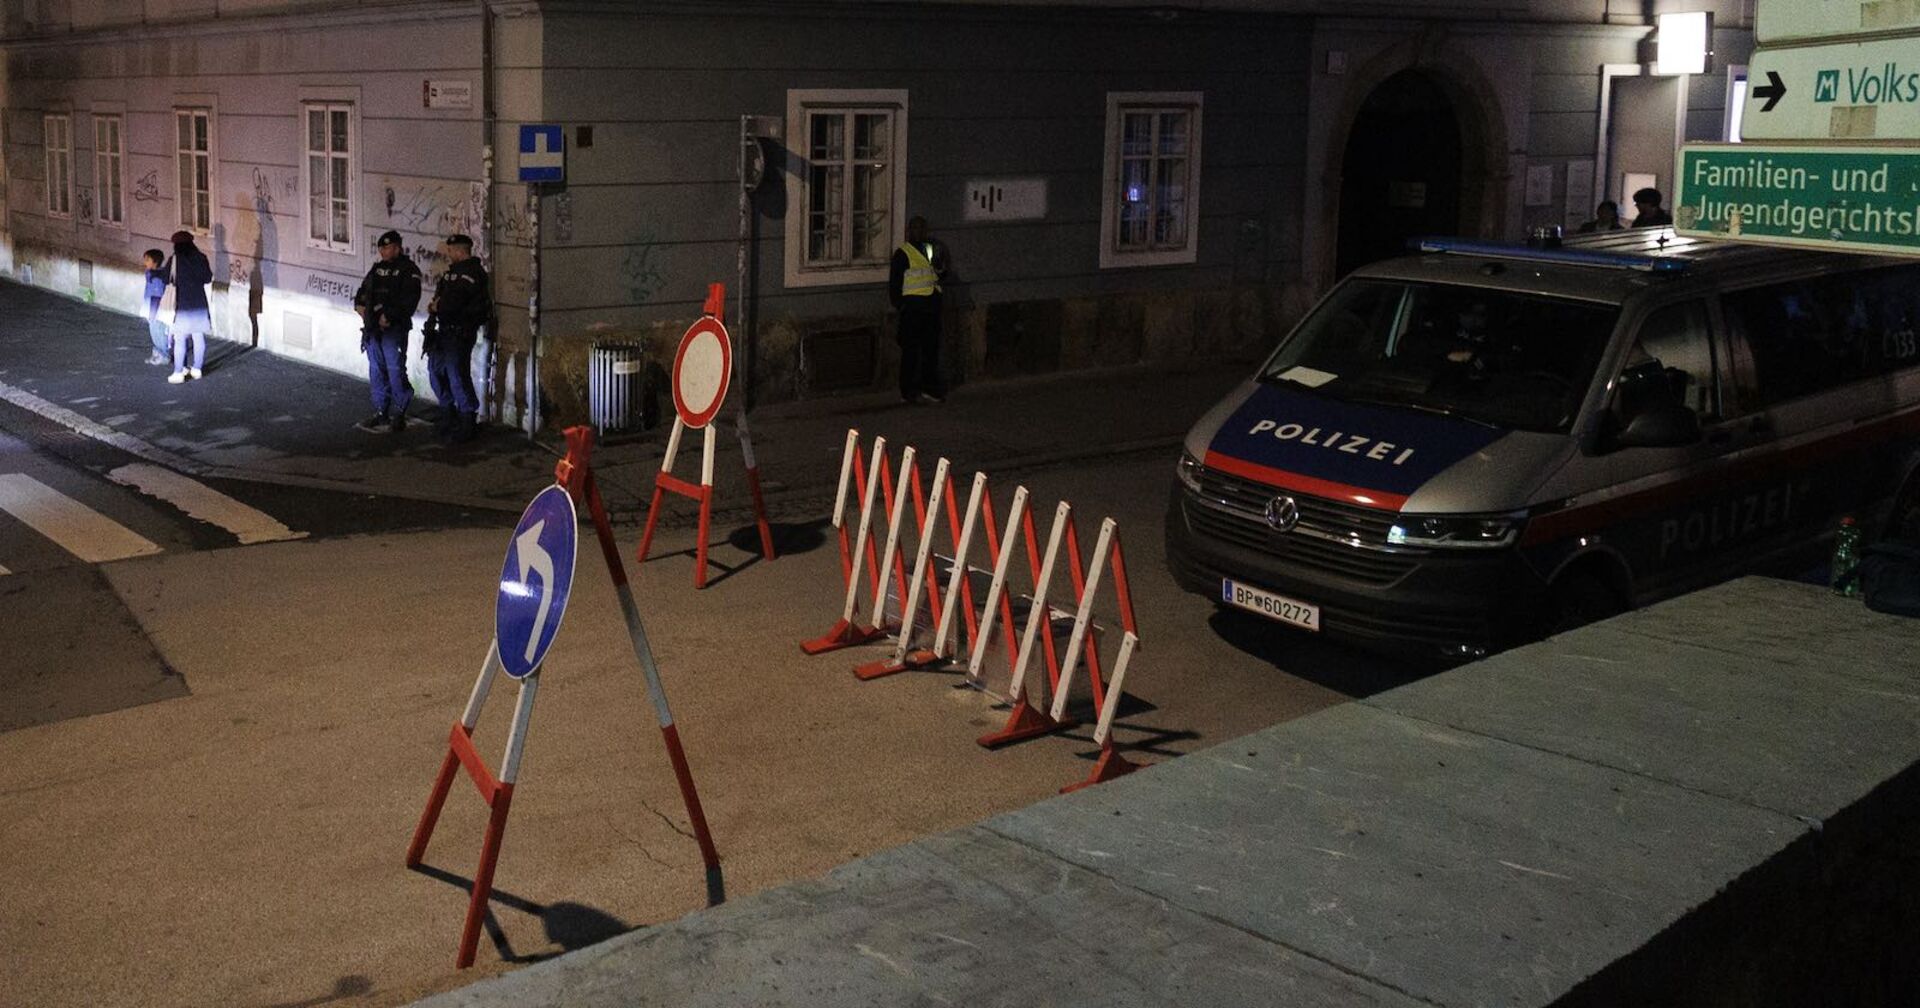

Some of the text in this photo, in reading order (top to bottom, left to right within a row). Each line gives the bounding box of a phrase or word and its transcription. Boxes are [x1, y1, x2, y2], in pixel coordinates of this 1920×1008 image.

[1694, 159, 1888, 193] Familien- und
[1249, 419, 1415, 466] POLIZEI
[1658, 482, 1793, 560] POLIZEI
[1263, 598, 1312, 625] 60272
